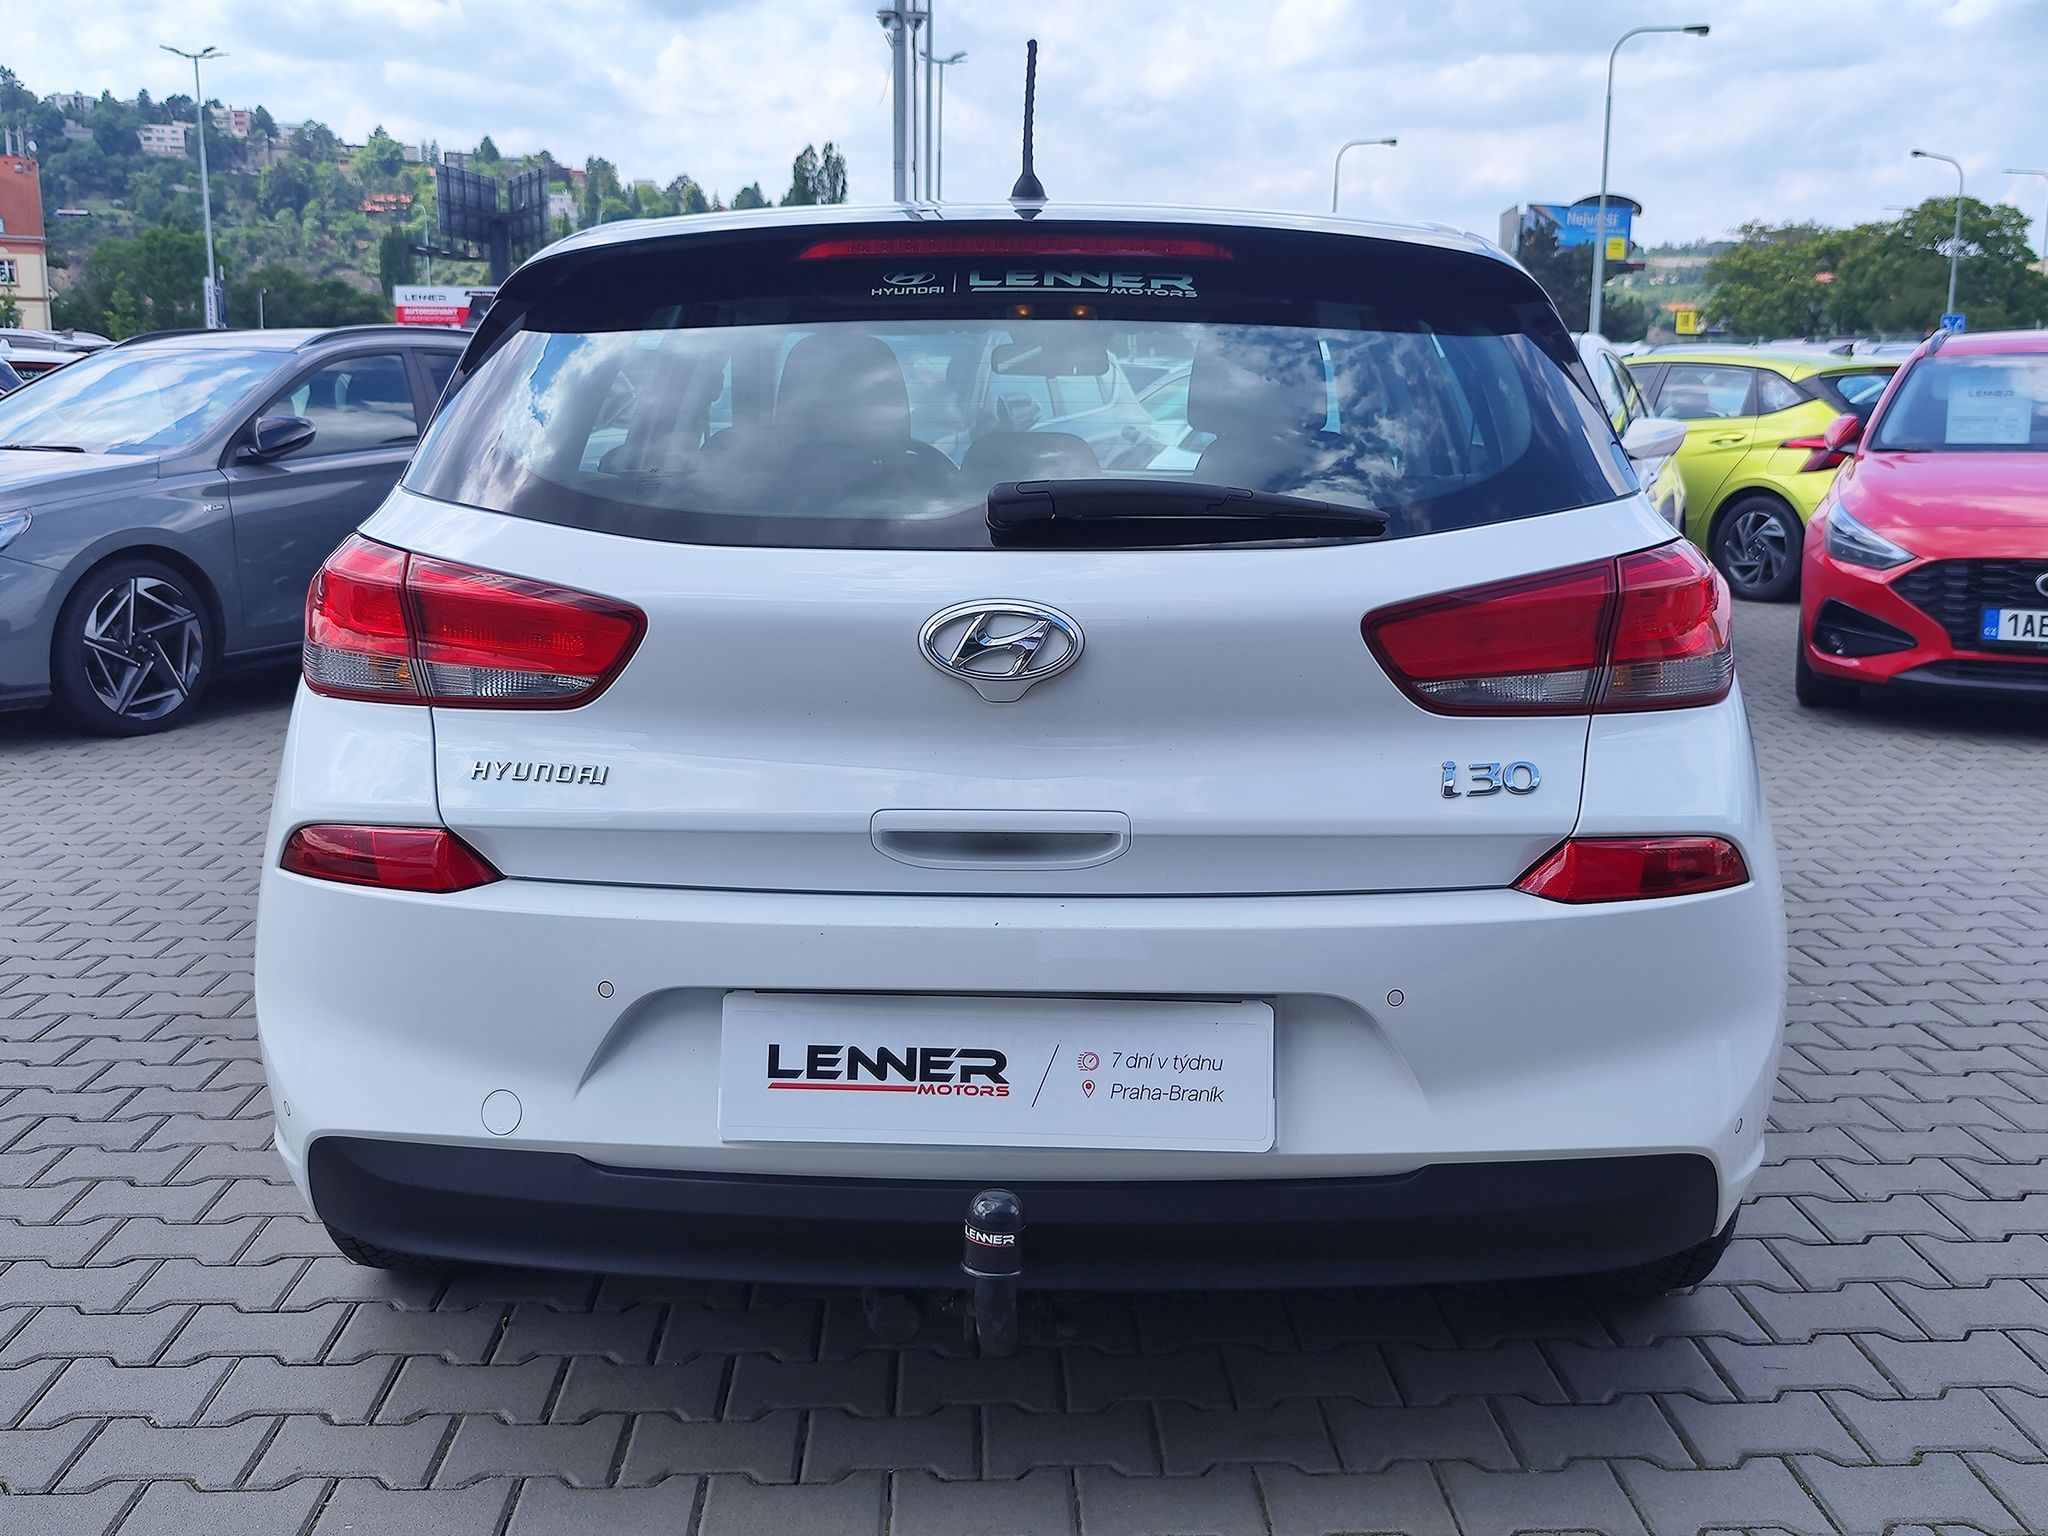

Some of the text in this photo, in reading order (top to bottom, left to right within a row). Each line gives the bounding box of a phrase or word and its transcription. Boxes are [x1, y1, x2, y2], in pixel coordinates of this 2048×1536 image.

[969, 270, 1195, 290] LENNER
[871, 286, 945, 296] HYUNDAI
[1110, 288, 1198, 298] MOTORS
[471, 761, 609, 785] HYUNDAI
[1441, 760, 1541, 799] i30
[767, 1043, 1011, 1085] LENNER
[1111, 1051, 1224, 1074] 7 dní v týdnu
[917, 1083, 1011, 1097] MOTORS
[1110, 1083, 1225, 1102] Praha-Braník
[965, 1224, 1016, 1245] LENNER
